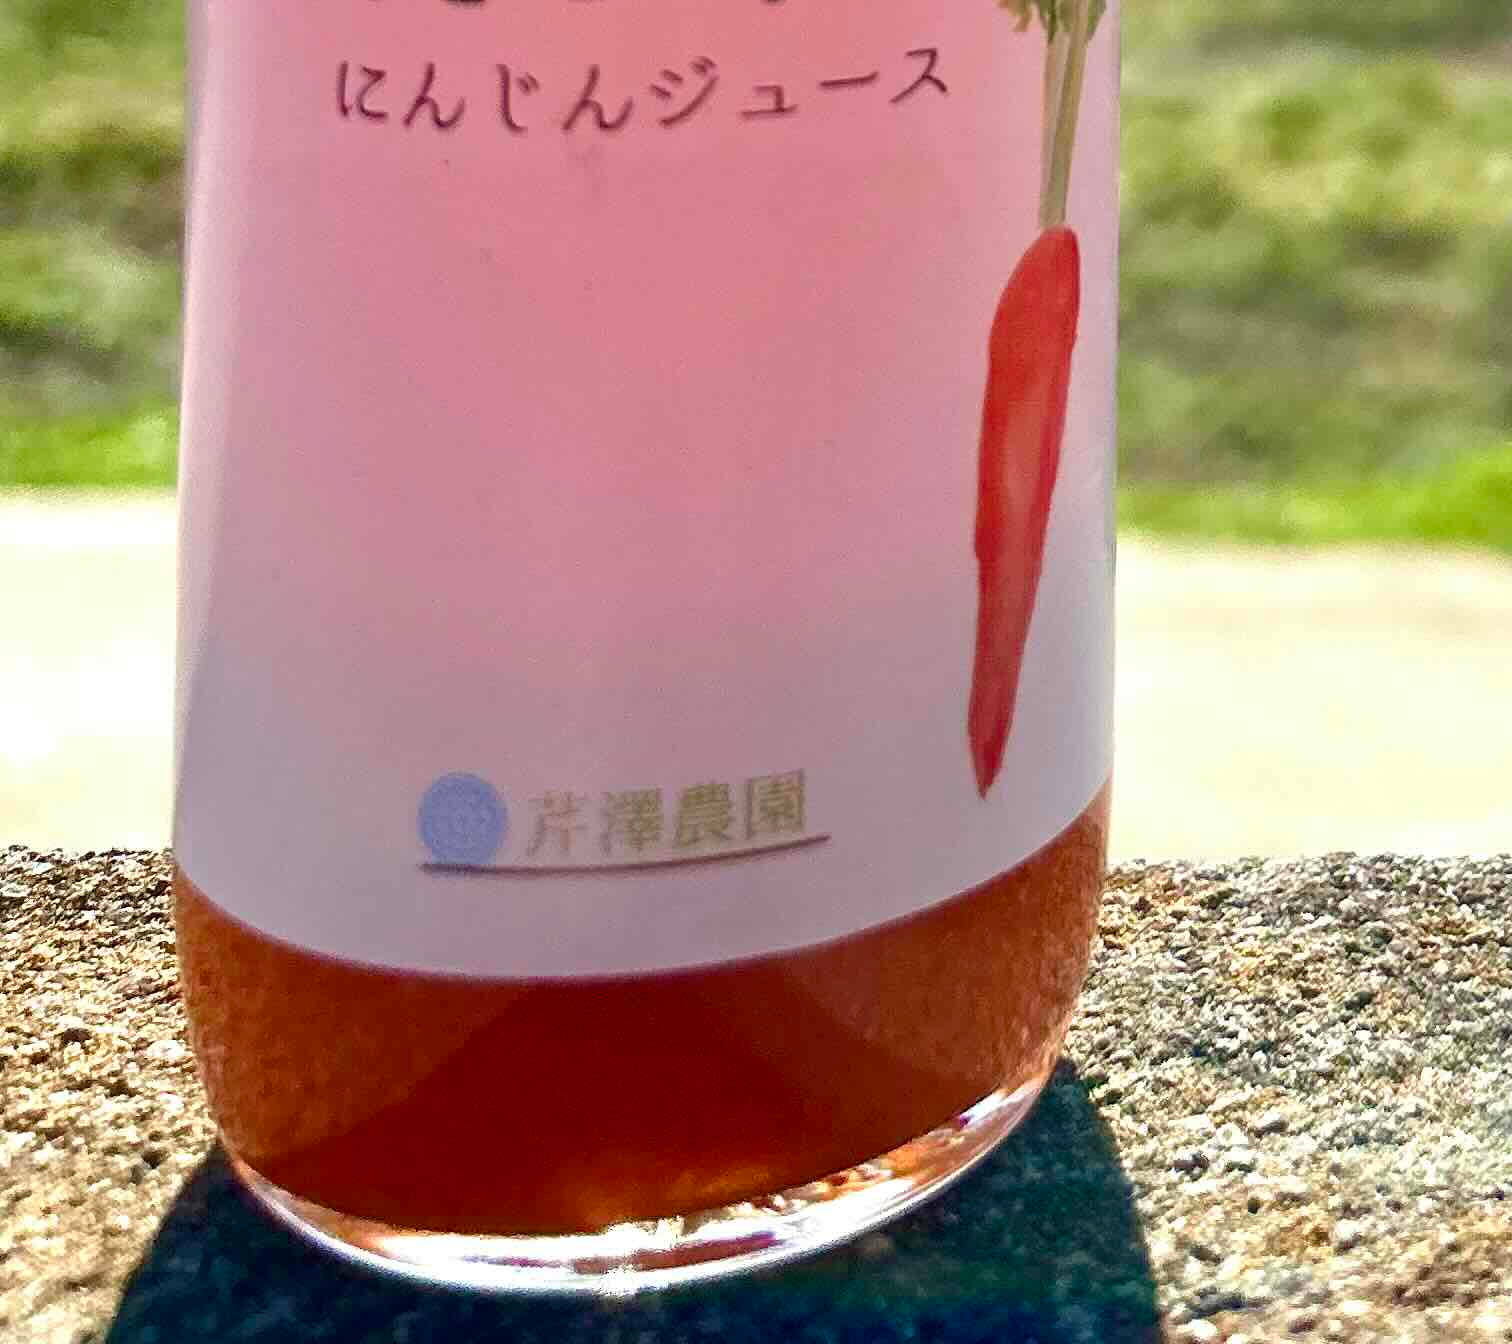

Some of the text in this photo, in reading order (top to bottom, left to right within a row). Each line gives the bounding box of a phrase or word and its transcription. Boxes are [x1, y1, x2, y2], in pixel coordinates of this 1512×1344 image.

[336, 47, 949, 133] にんじんジュース
[525, 768, 806, 857] 芹澤農園
